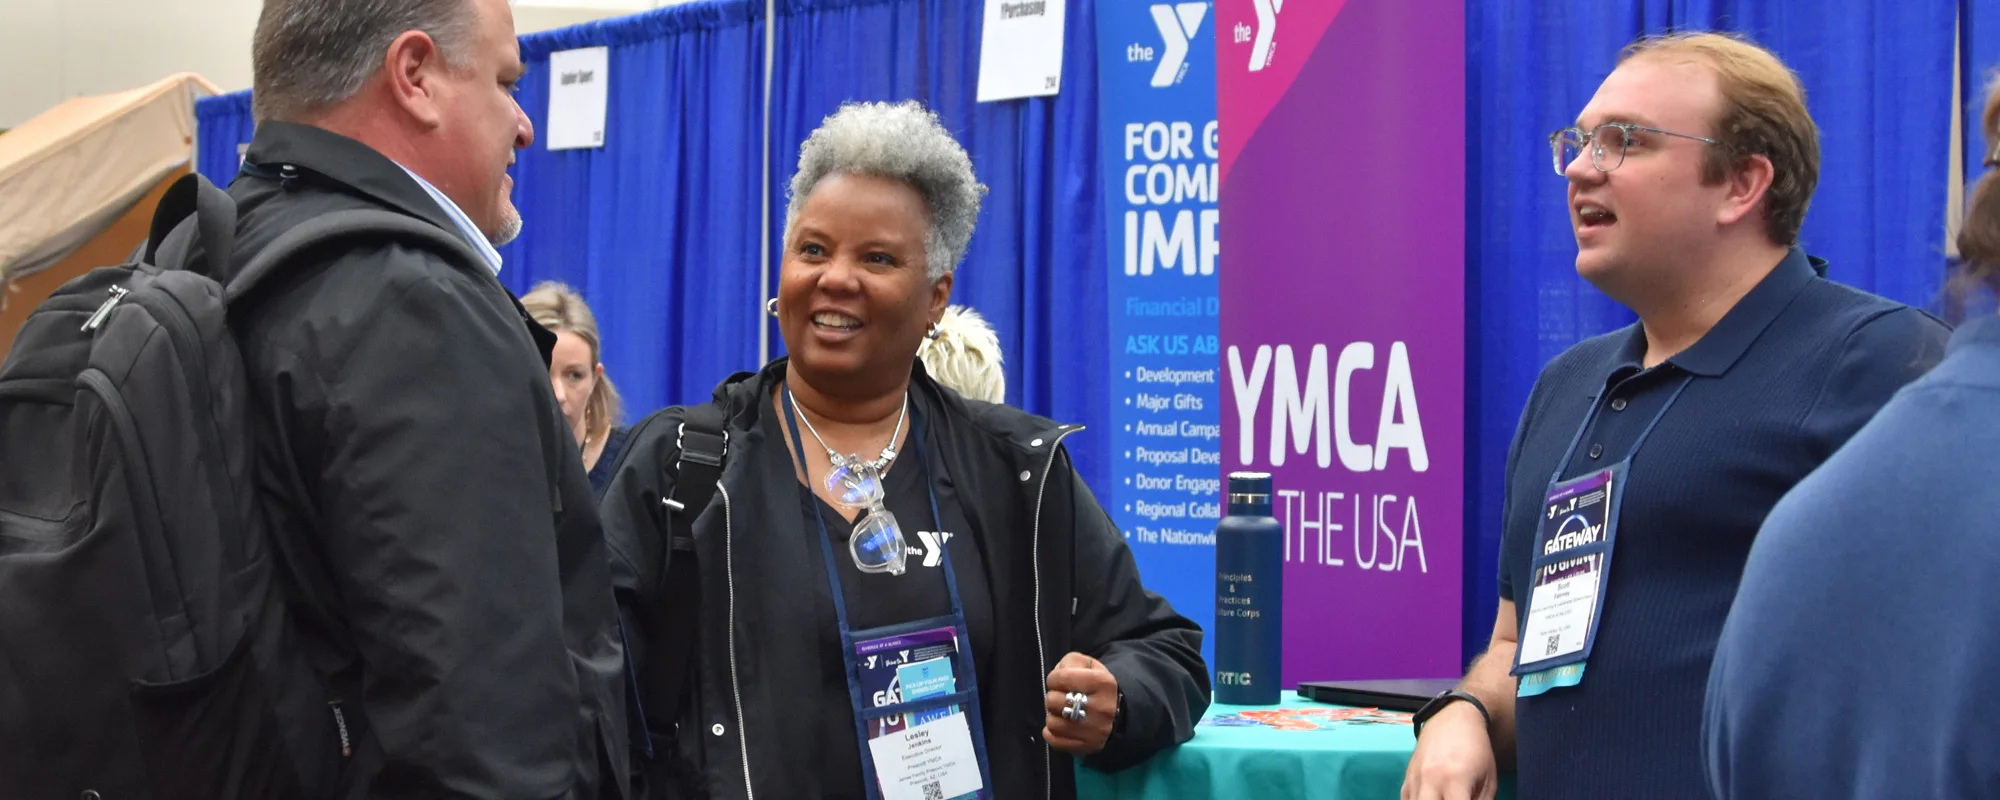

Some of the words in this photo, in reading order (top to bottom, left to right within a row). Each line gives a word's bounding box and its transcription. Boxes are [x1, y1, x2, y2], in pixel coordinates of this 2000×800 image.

[1234, 21, 1251, 43] the
[1127, 43, 1154, 62] the
[1125, 121, 1194, 161] FOR
[1125, 163, 1219, 205] COM
[1126, 296, 1202, 316] Financial
[1125, 334, 1161, 355] ASK
[1164, 335, 1189, 355] US
[1192, 335, 1219, 355] AB
[1136, 366, 1215, 386] Development
[1136, 393, 1171, 413] Major
[1173, 393, 1203, 410] Gifts
[1227, 341, 1429, 472] YMCA
[1136, 419, 1178, 436] Annual
[1135, 445, 1188, 467] Proposal
[1135, 472, 1172, 490] Donor
[1175, 474, 1220, 495] Engage
[1135, 499, 1186, 520] Regional
[1135, 526, 1158, 544] The
[1278, 489, 1344, 566] THE
[1354, 493, 1427, 573] USA
[1544, 523, 1602, 556] GATEWAY
[907, 545, 923, 556] the
[1229, 583, 1236, 593] &
[1236, 608, 1260, 619] Corps
[1217, 671, 1252, 686] RTIC
[905, 729, 930, 742] Lesley
[907, 738, 932, 750] Jenkins
